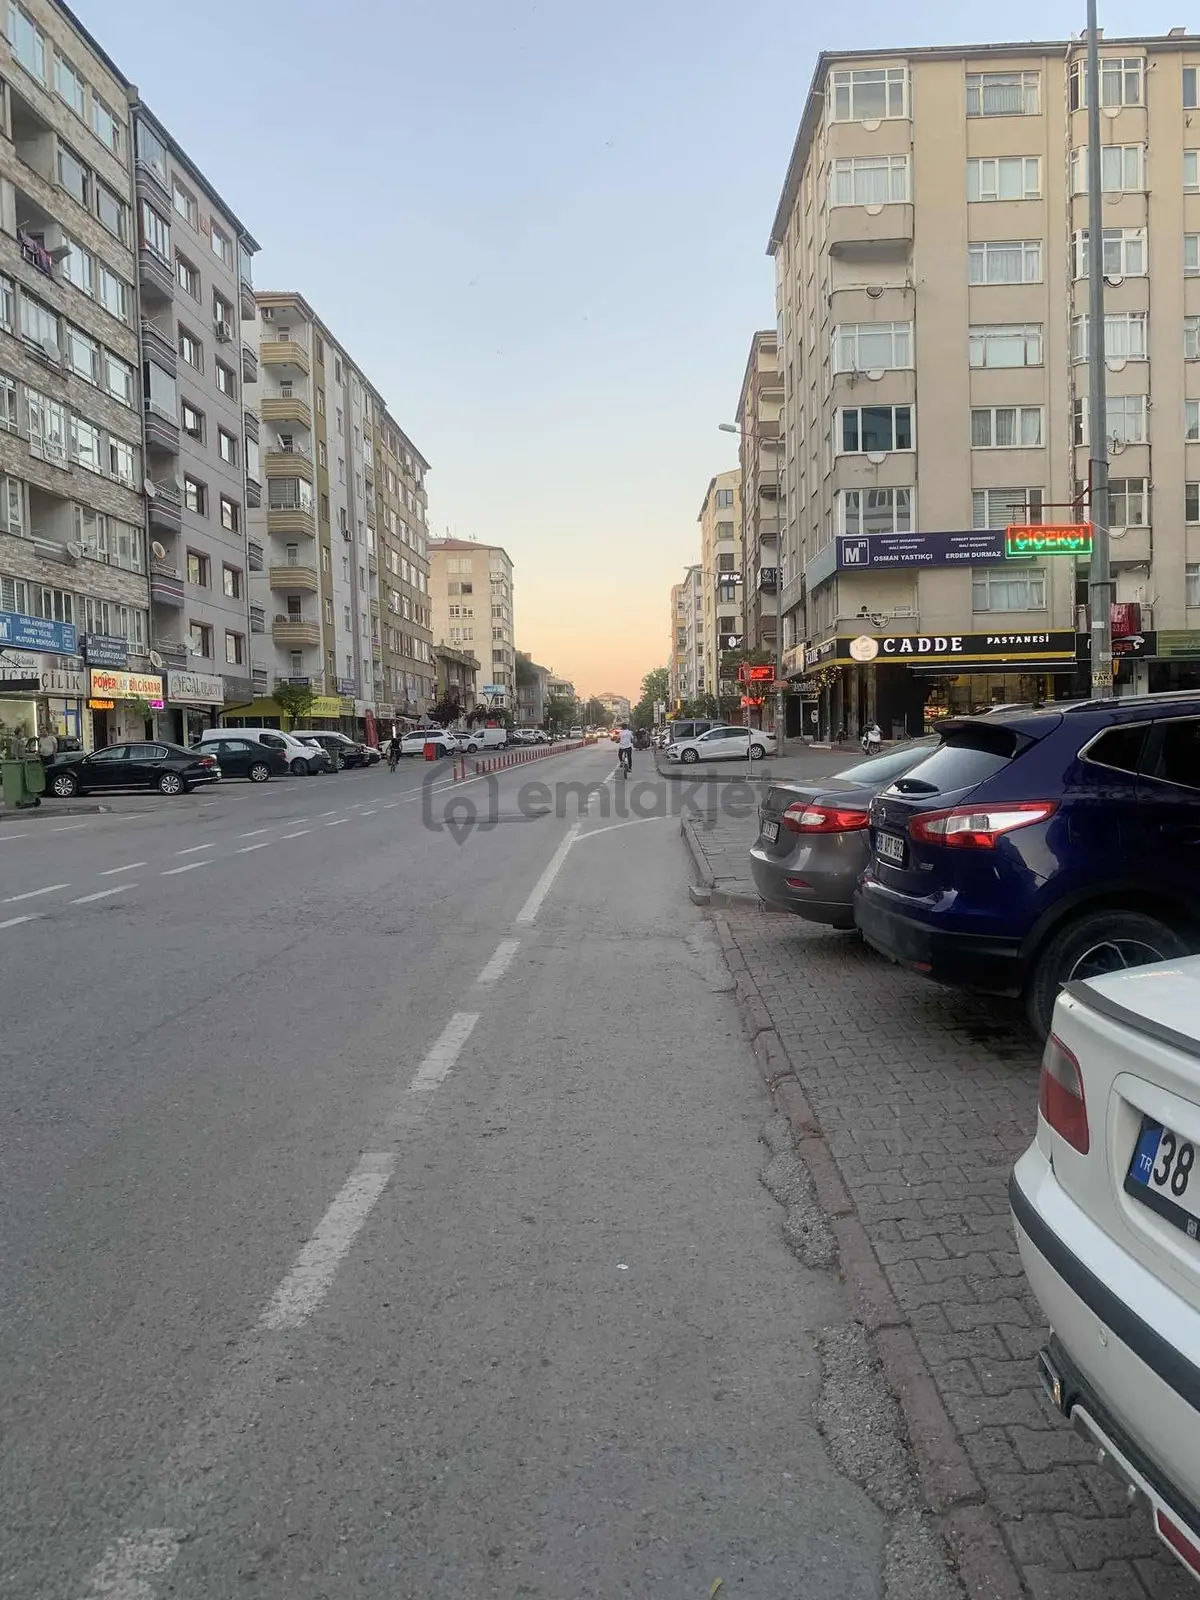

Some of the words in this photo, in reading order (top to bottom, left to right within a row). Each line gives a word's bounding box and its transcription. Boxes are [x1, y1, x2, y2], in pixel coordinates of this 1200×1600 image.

[1015, 528, 1084, 550] ÇİÇEKÇİ
[873, 554, 899, 562] OSMAN
[900, 553, 933, 561] YASTIKÇI
[883, 637, 963, 653] CADDE
[987, 633, 1049, 645] PASTANESİ
[1139, 1153, 1153, 1174] TR
[1153, 1132, 1195, 1197] 38
